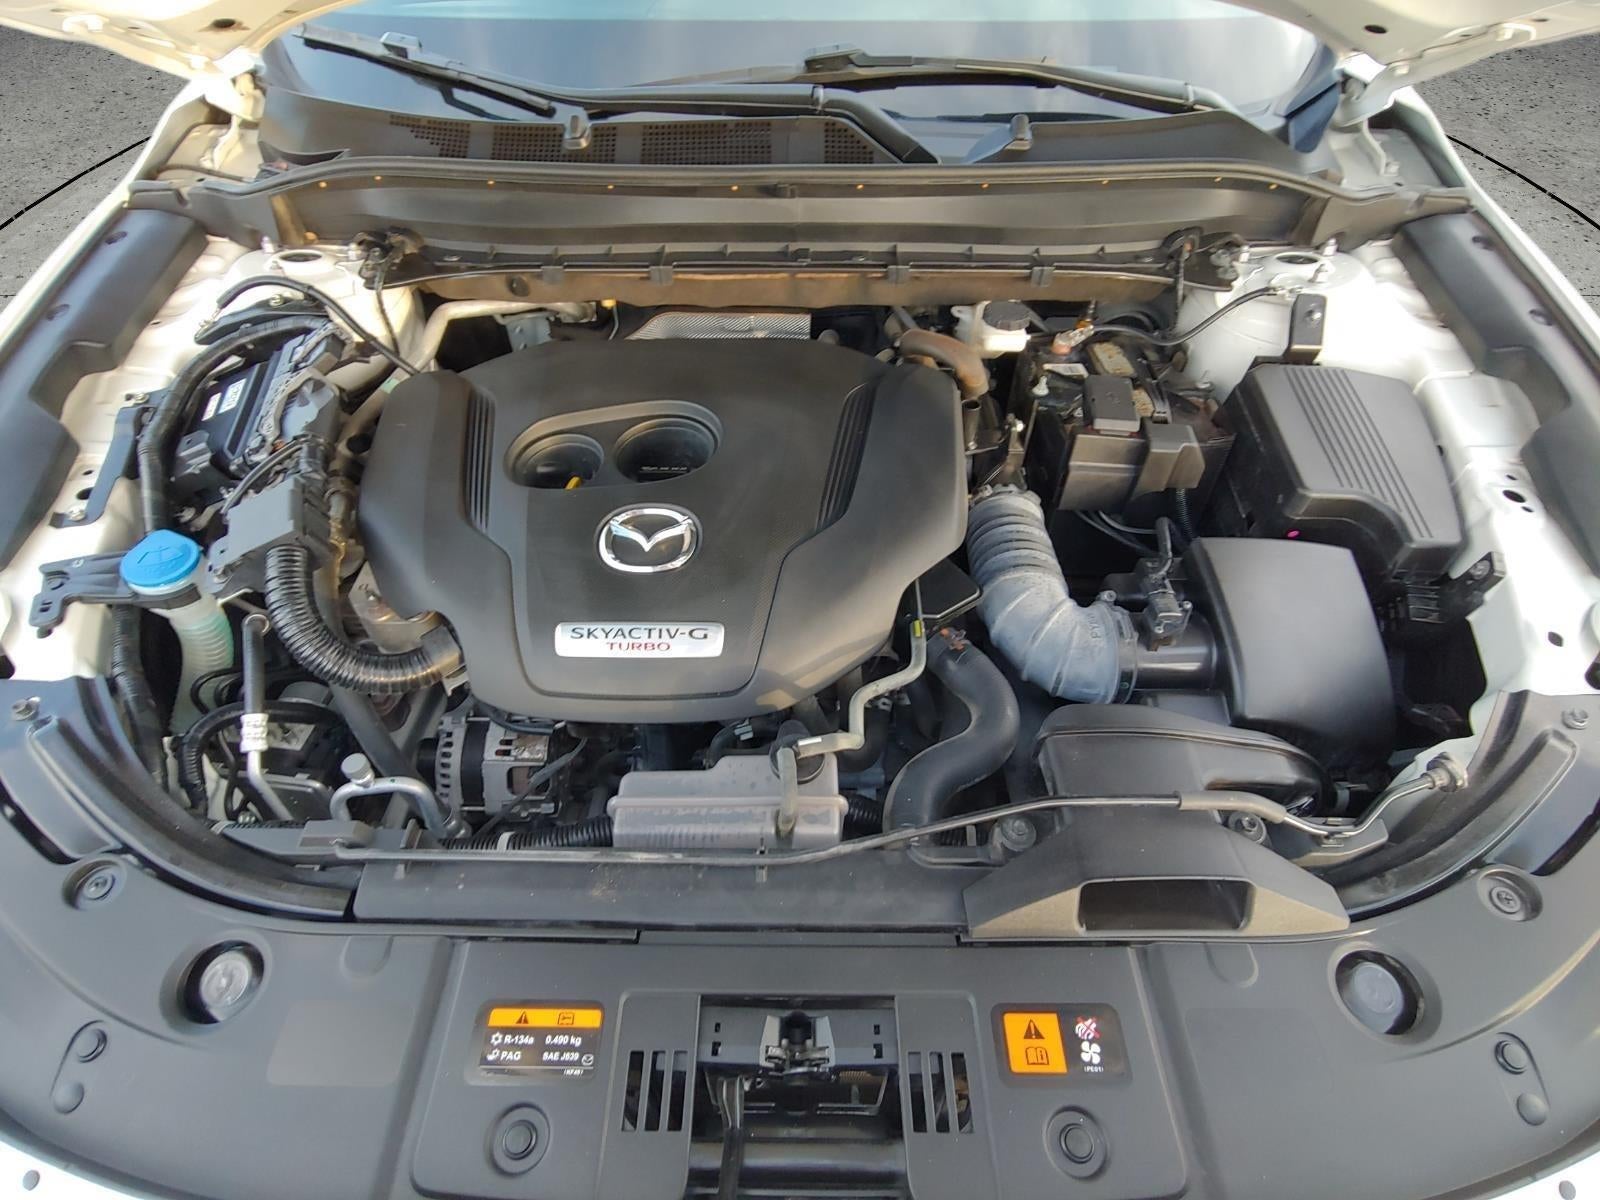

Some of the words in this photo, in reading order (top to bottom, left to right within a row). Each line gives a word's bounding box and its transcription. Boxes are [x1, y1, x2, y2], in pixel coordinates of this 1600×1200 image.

[570, 627, 709, 640] SKYACTIV-G
[606, 642, 671, 651] TURBO
[503, 1034, 535, 1045] R-134a
[570, 1034, 582, 1048] kg
[500, 1051, 522, 1061] PAG
[542, 1051, 560, 1061] SAE
